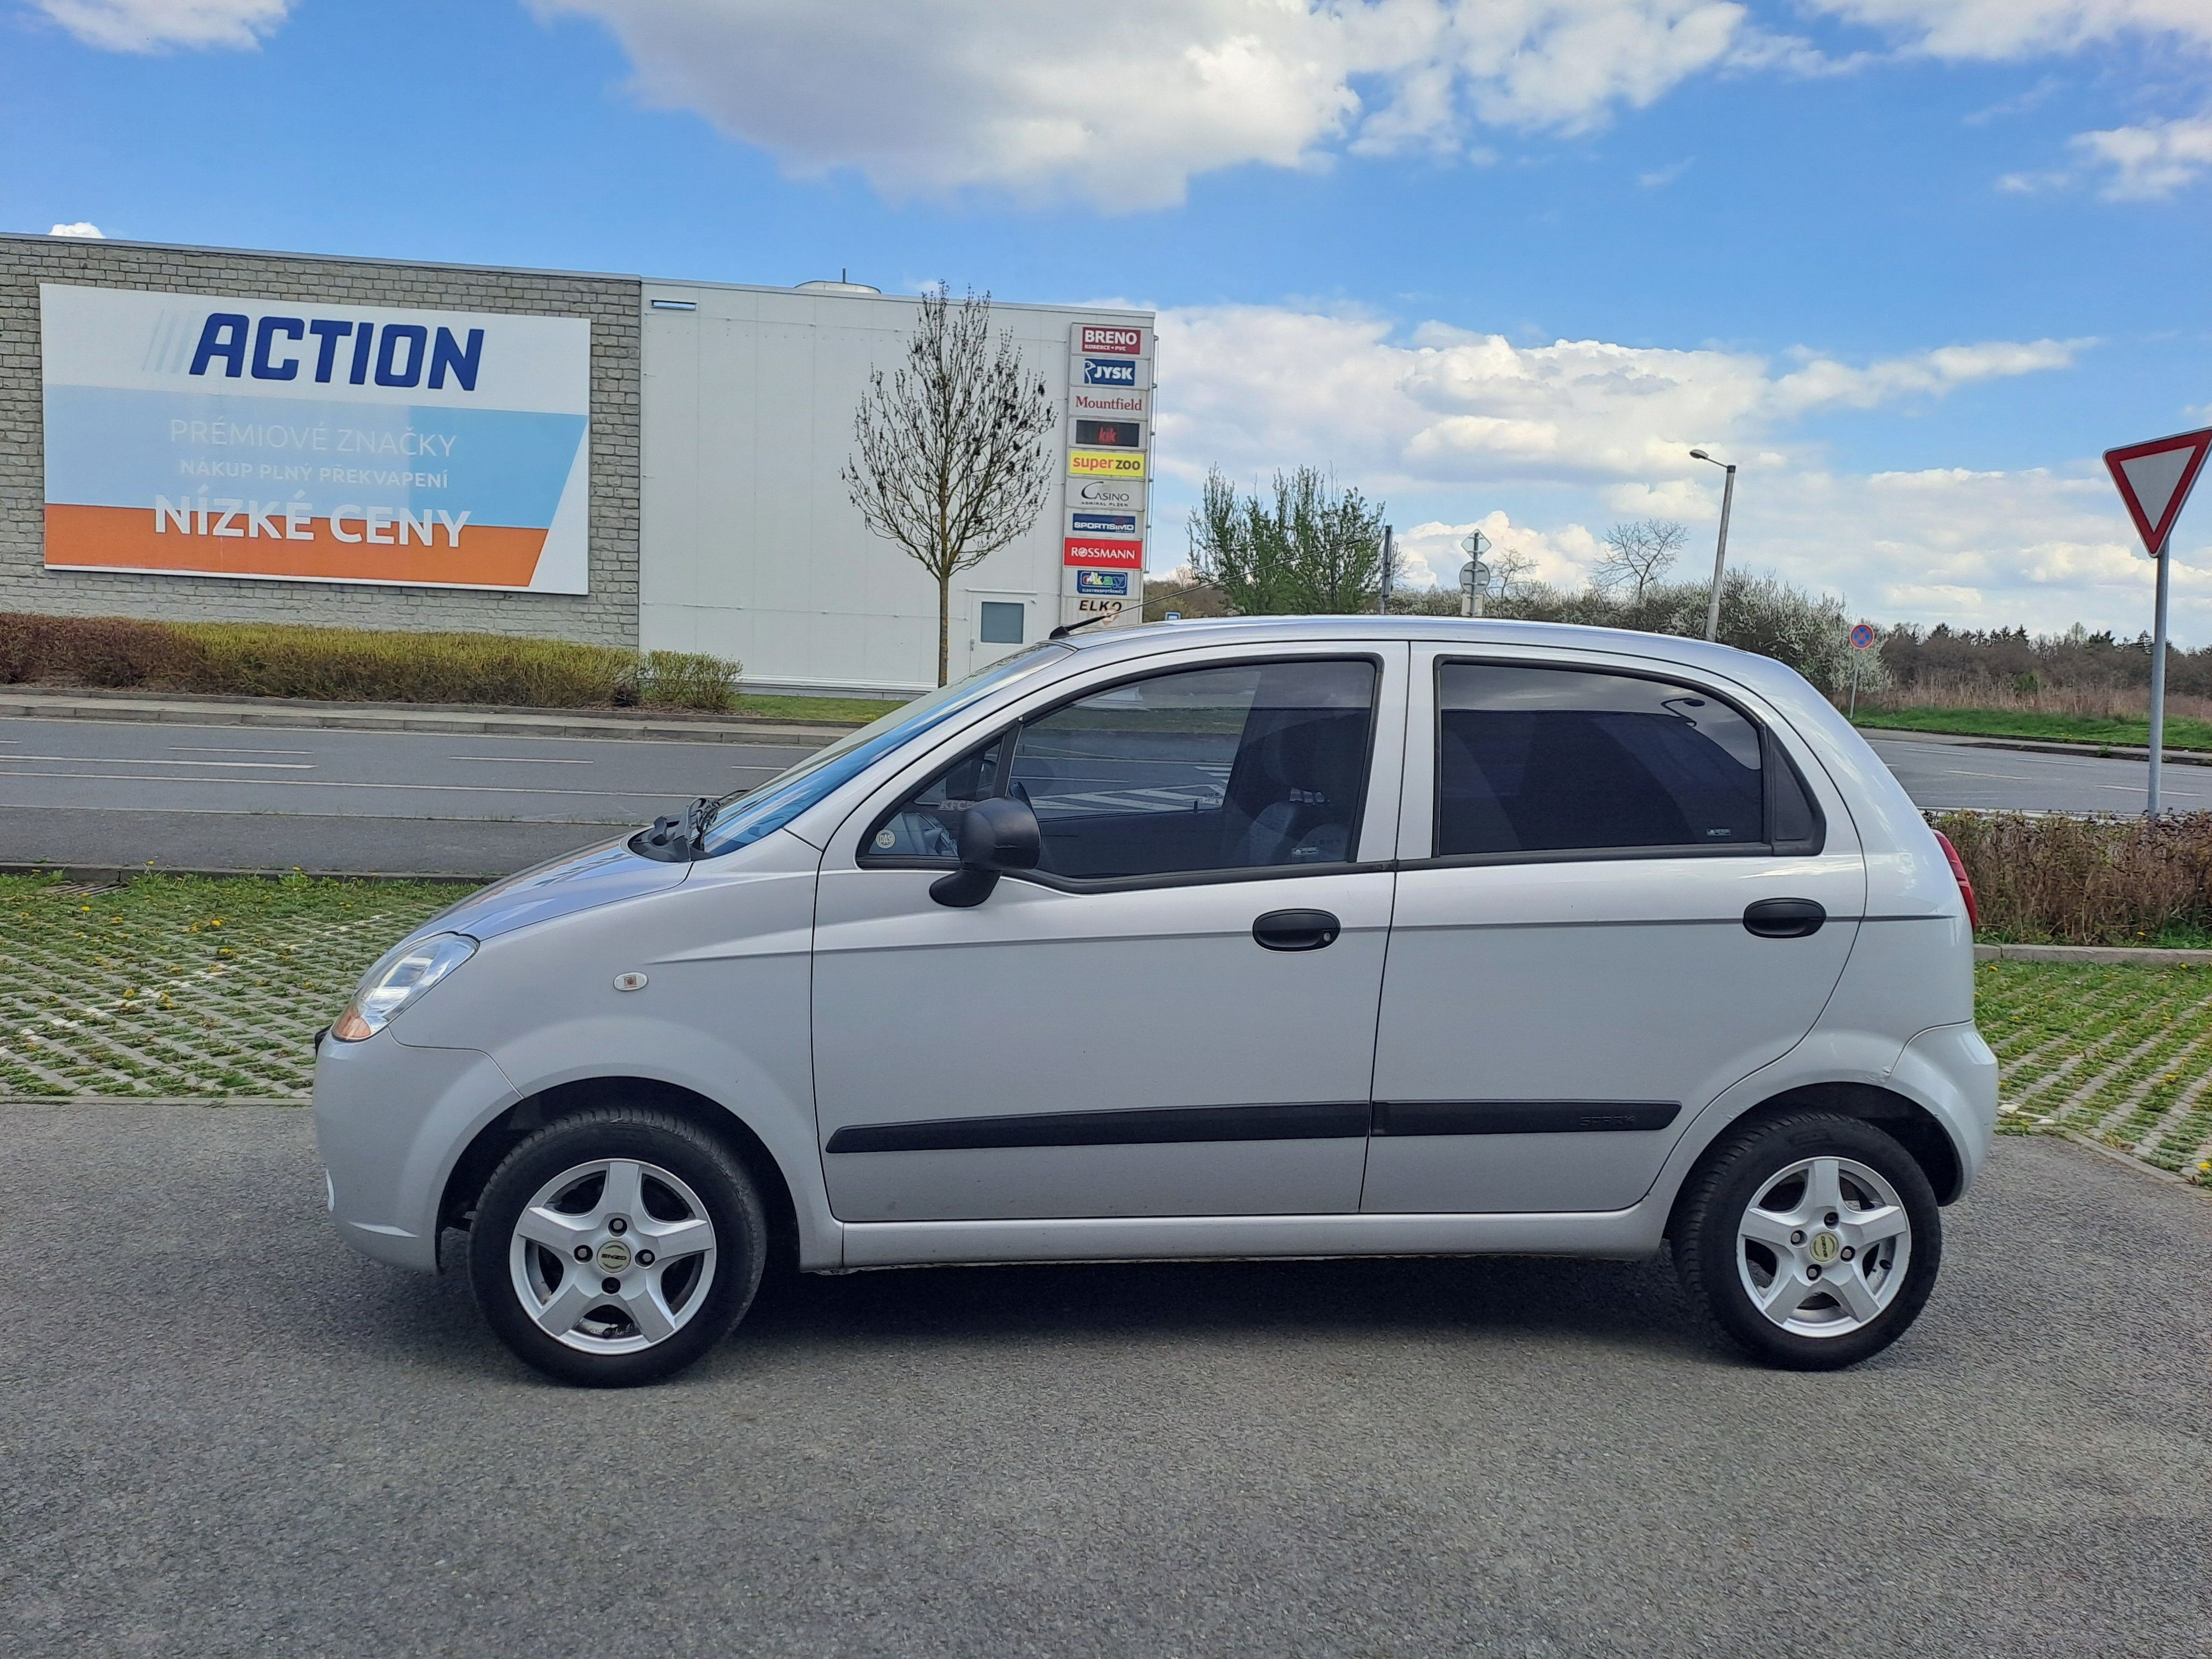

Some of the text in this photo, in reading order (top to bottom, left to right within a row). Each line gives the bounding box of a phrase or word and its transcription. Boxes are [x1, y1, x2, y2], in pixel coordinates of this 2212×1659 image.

[1084, 330, 1138, 346] BRENO
[189, 313, 484, 391] ACTION
[1094, 365, 1133, 380] JYSK
[1076, 395, 1142, 411] Mountfield
[171, 416, 457, 457] PRÉMIOVÉ ZNAČKY
[1098, 427, 1117, 443] kik
[180, 457, 448, 488] NÁKUP PLNÝ PŘEKVAPENÍ
[155, 484, 472, 547] NÍZKÉ CENY
[1071, 547, 1135, 560] ROSSMANN
